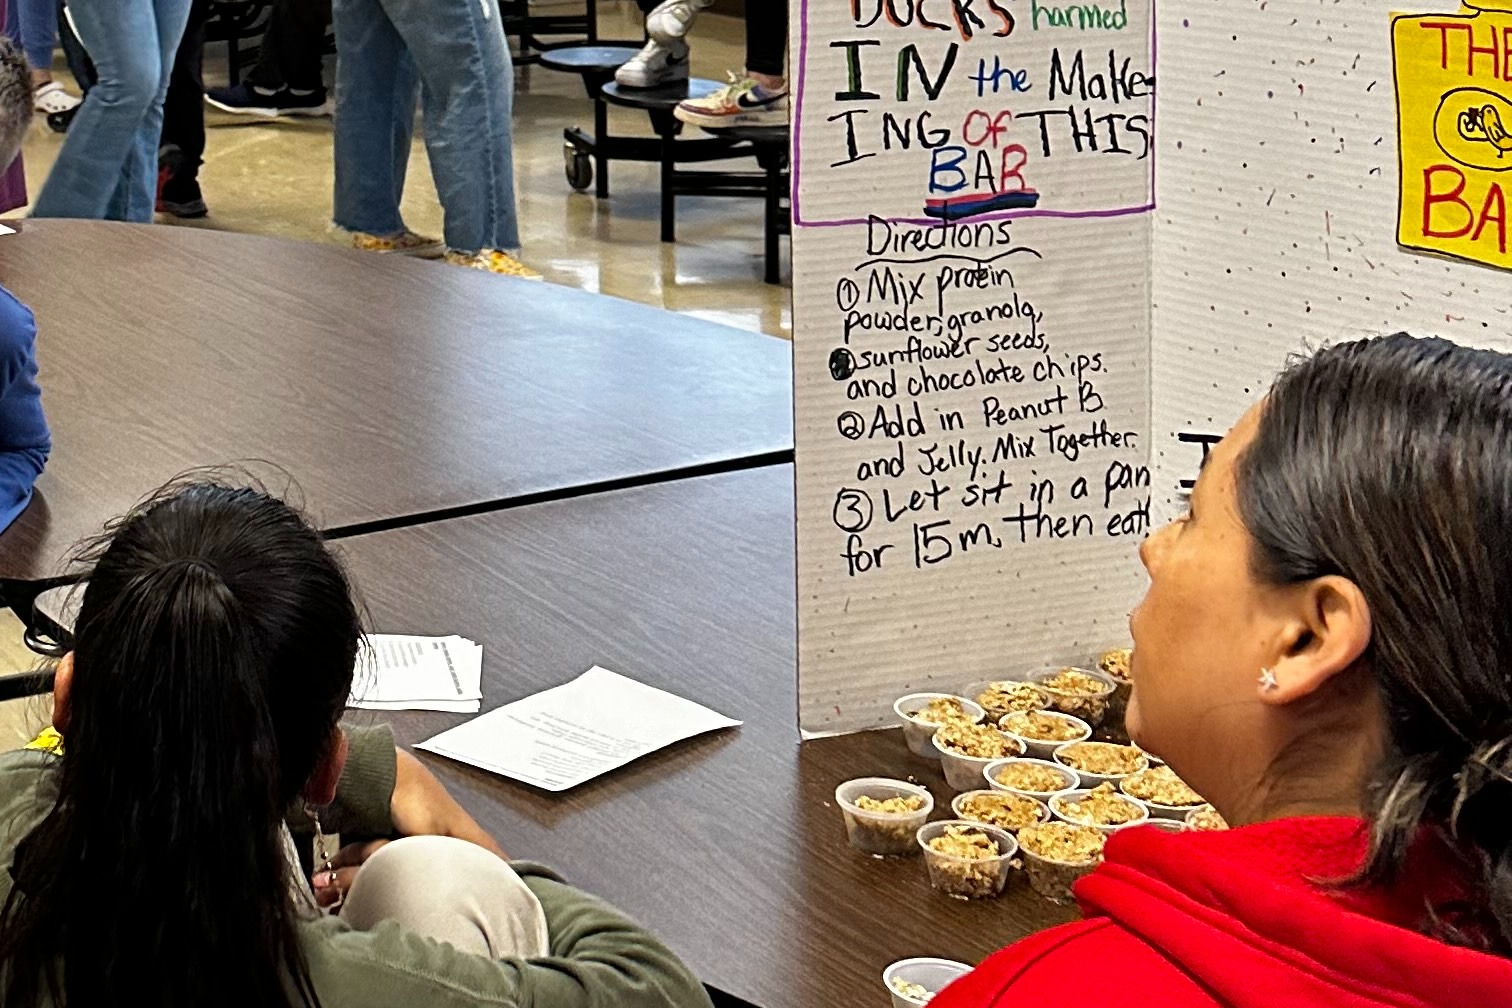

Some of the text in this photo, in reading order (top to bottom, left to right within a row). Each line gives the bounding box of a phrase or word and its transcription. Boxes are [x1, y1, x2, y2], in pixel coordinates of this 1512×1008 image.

[829, 40, 959, 102] IN
[968, 55, 1032, 96] the
[827, 110, 951, 167] ING
[1015, 105, 1149, 160] THIS
[929, 144, 1036, 193] BAR
[867, 204, 1012, 255] Directions
[867, 266, 926, 305] Mix
[857, 336, 981, 369] sunflower
[847, 369, 897, 400] and
[907, 359, 1025, 396] chocolate
[868, 401, 926, 439] Add
[934, 408, 964, 430] in
[982, 385, 1068, 427] Peanut
[857, 441, 905, 481] and
[992, 433, 1036, 463] Mix
[883, 479, 950, 522] Let
[961, 470, 1013, 507] sit
[1030, 469, 1054, 504] in
[1071, 477, 1088, 499] a
[1104, 460, 1151, 509] pan
[840, 533, 895, 577] for
[1002, 502, 1093, 543] then
